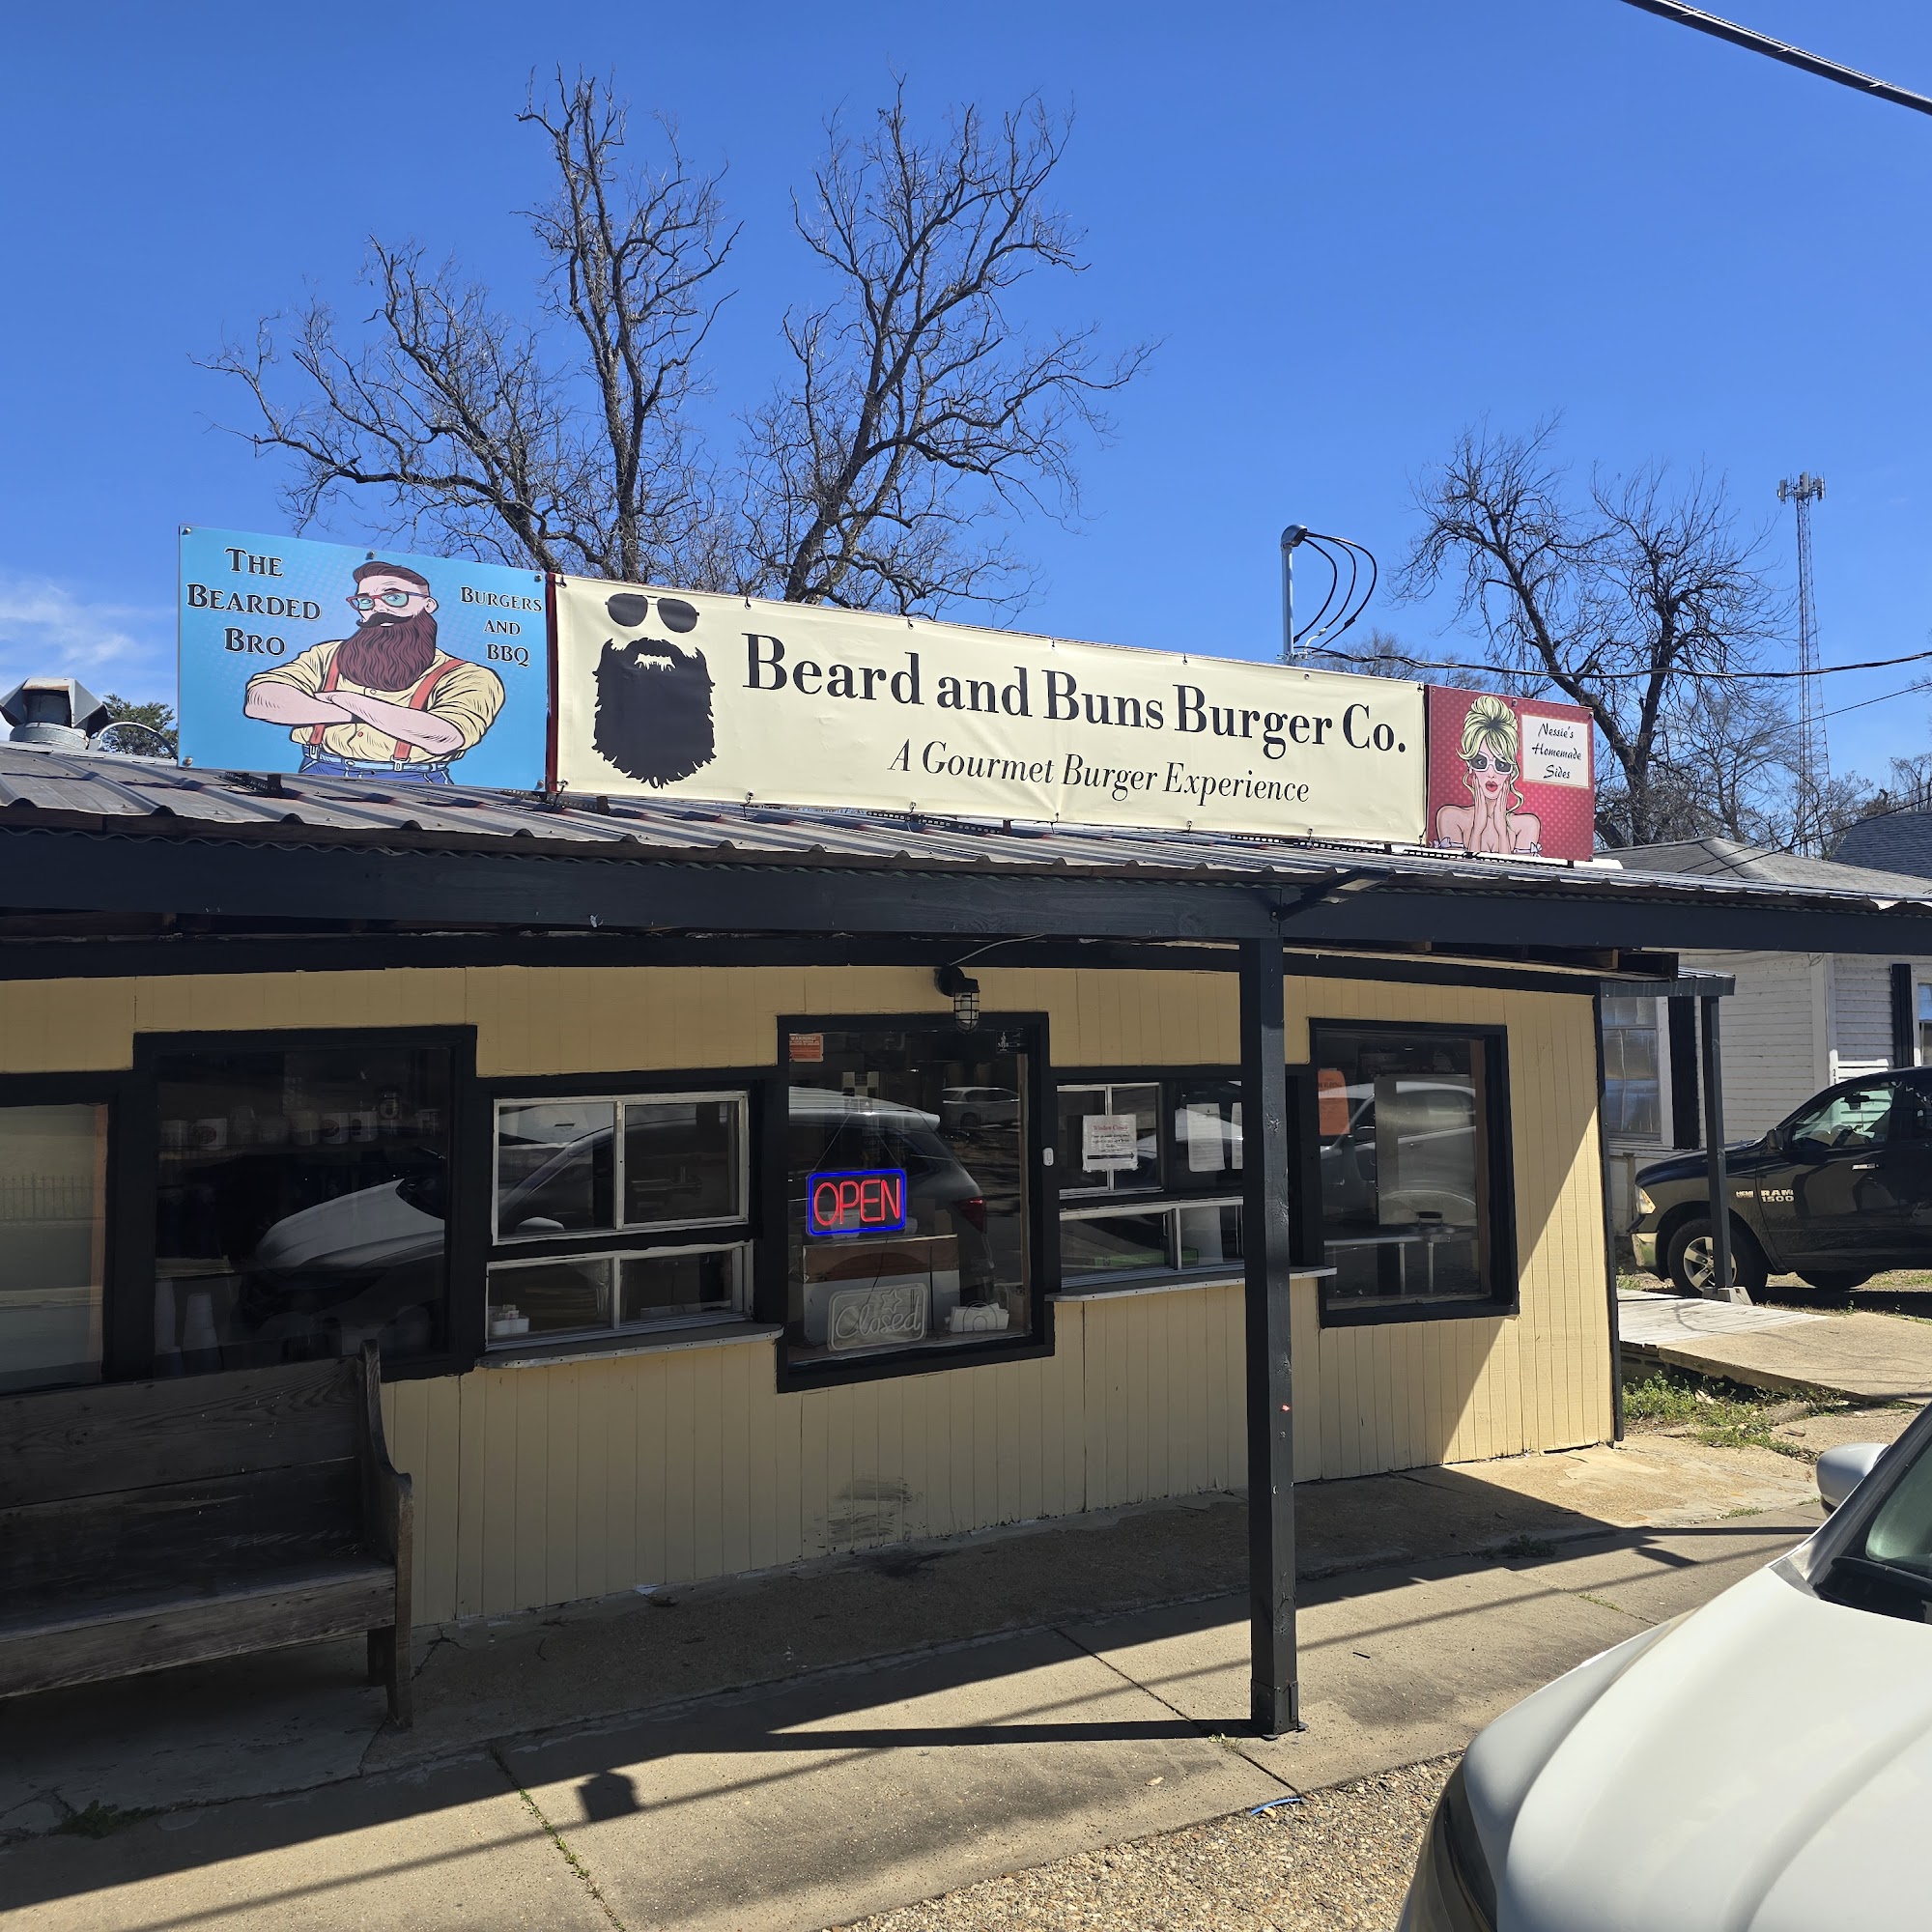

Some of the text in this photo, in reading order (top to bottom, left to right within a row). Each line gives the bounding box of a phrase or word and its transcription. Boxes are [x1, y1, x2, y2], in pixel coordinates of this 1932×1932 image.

[224, 548, 284, 577] THE
[186, 583, 321, 621] BEARDED
[460, 586, 543, 612] BURGERS
[224, 627, 286, 656] BRO
[484, 619, 521, 636] AND
[486, 642, 530, 667] BBQ
[741, 633, 1406, 759] Beard and Buns Burger Co.
[1537, 723, 1574, 739] Nessie's
[1531, 743, 1582, 761] Homemade
[887, 738, 1310, 807] A Gourmet Burger Experience
[1543, 764, 1570, 779] Sides
[813, 1178, 901, 1226] OPEN
[835, 1290, 922, 1340] Closed
